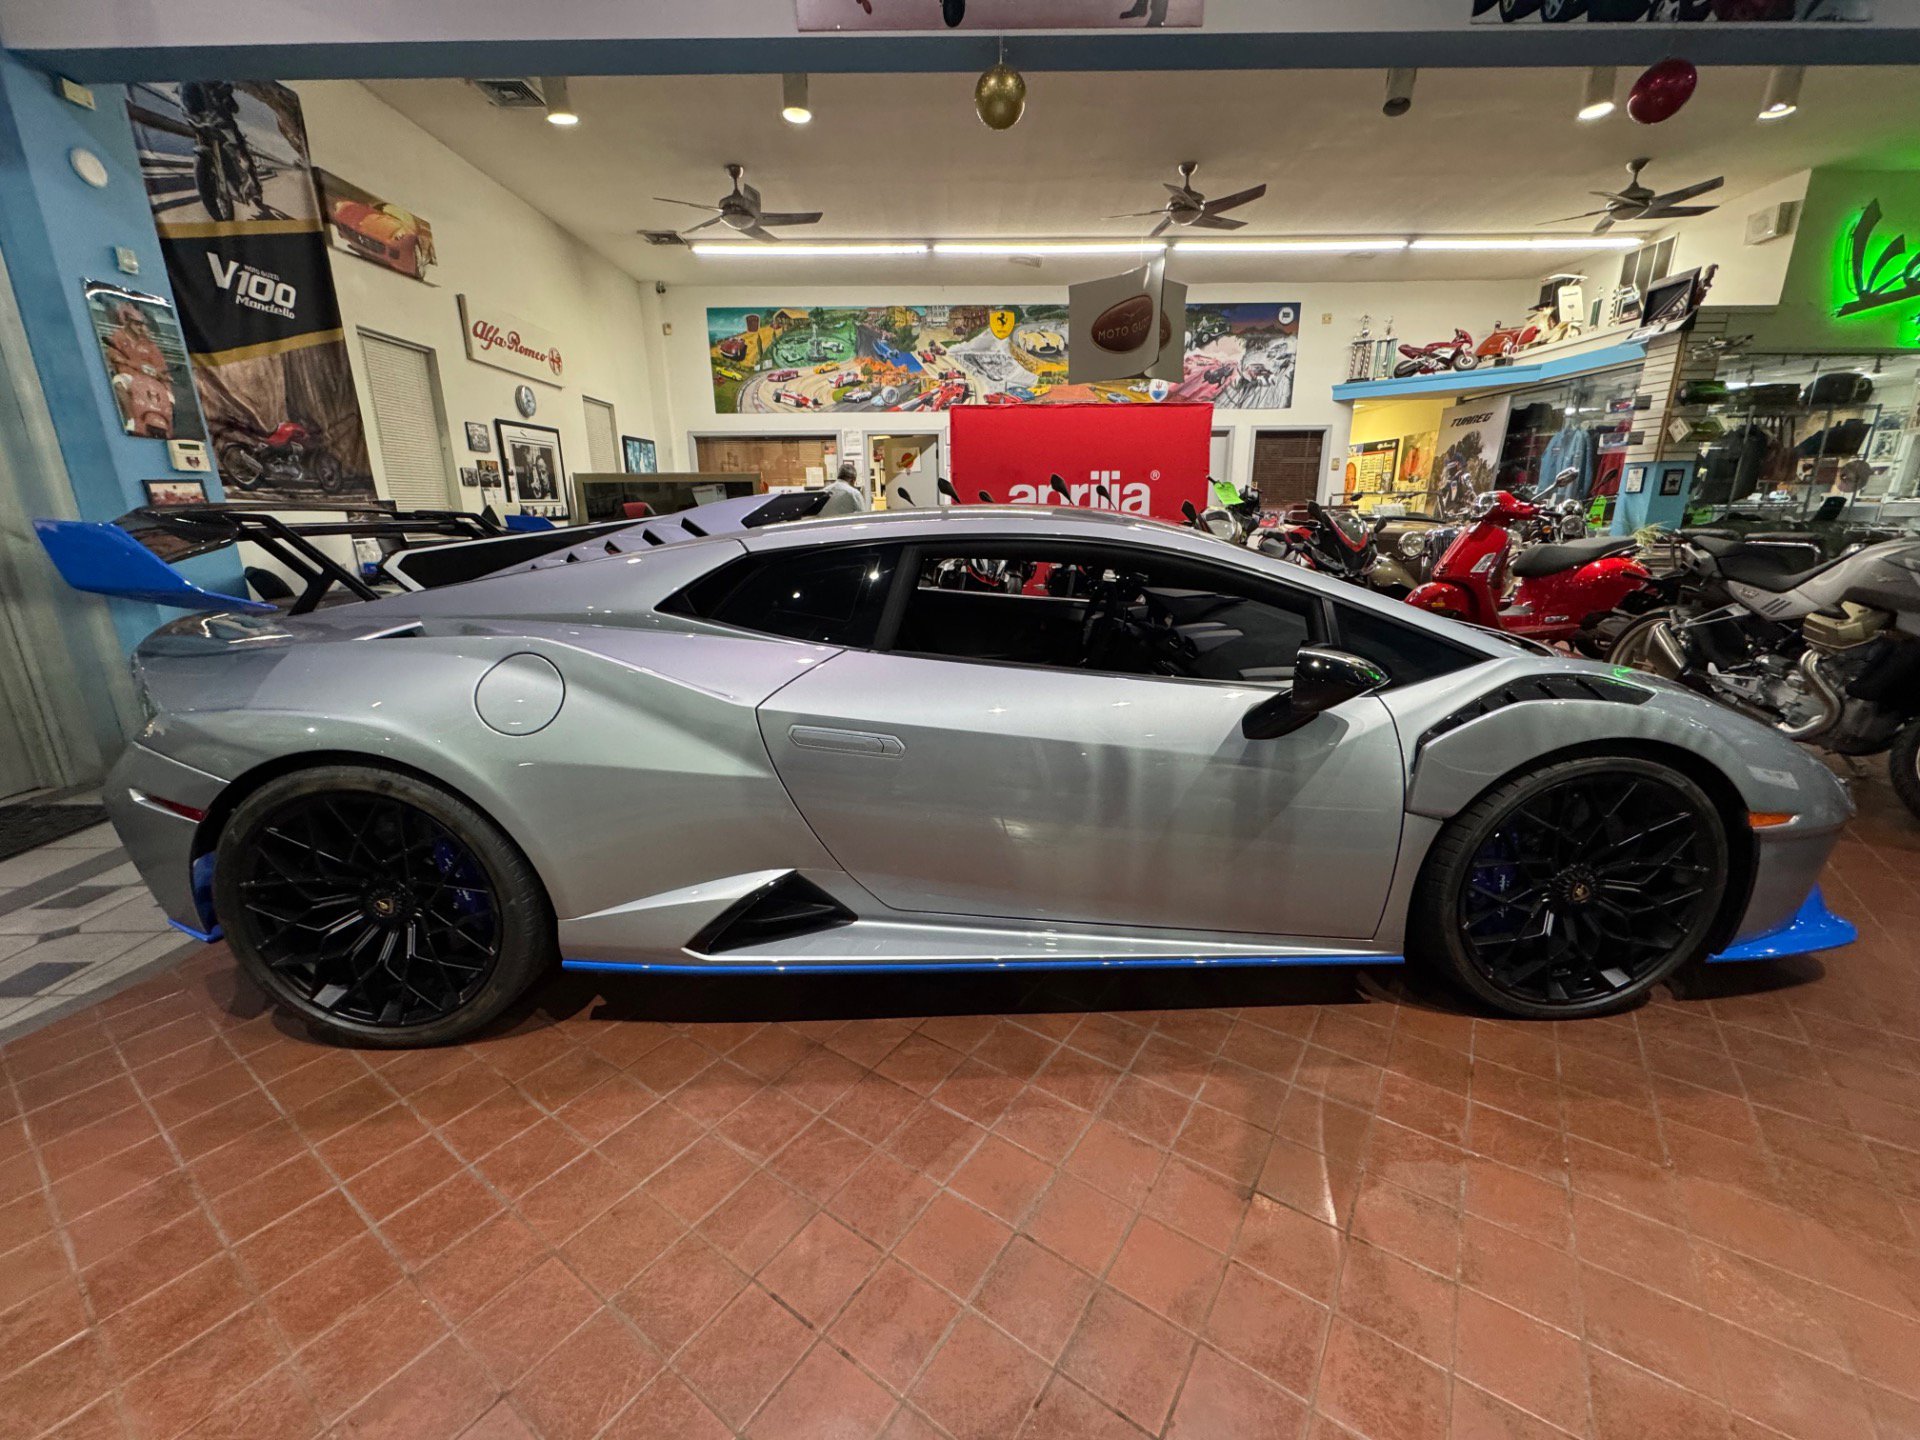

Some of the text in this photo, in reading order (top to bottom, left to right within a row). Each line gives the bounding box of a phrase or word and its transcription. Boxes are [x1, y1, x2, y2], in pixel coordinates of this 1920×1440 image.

[206, 251, 297, 309] V100
[235, 294, 296, 320] Mandello
[472, 320, 548, 362] Alfa Romeo
[1098, 326, 1129, 340] MOTO
[1450, 412, 1494, 427] TUAREG
